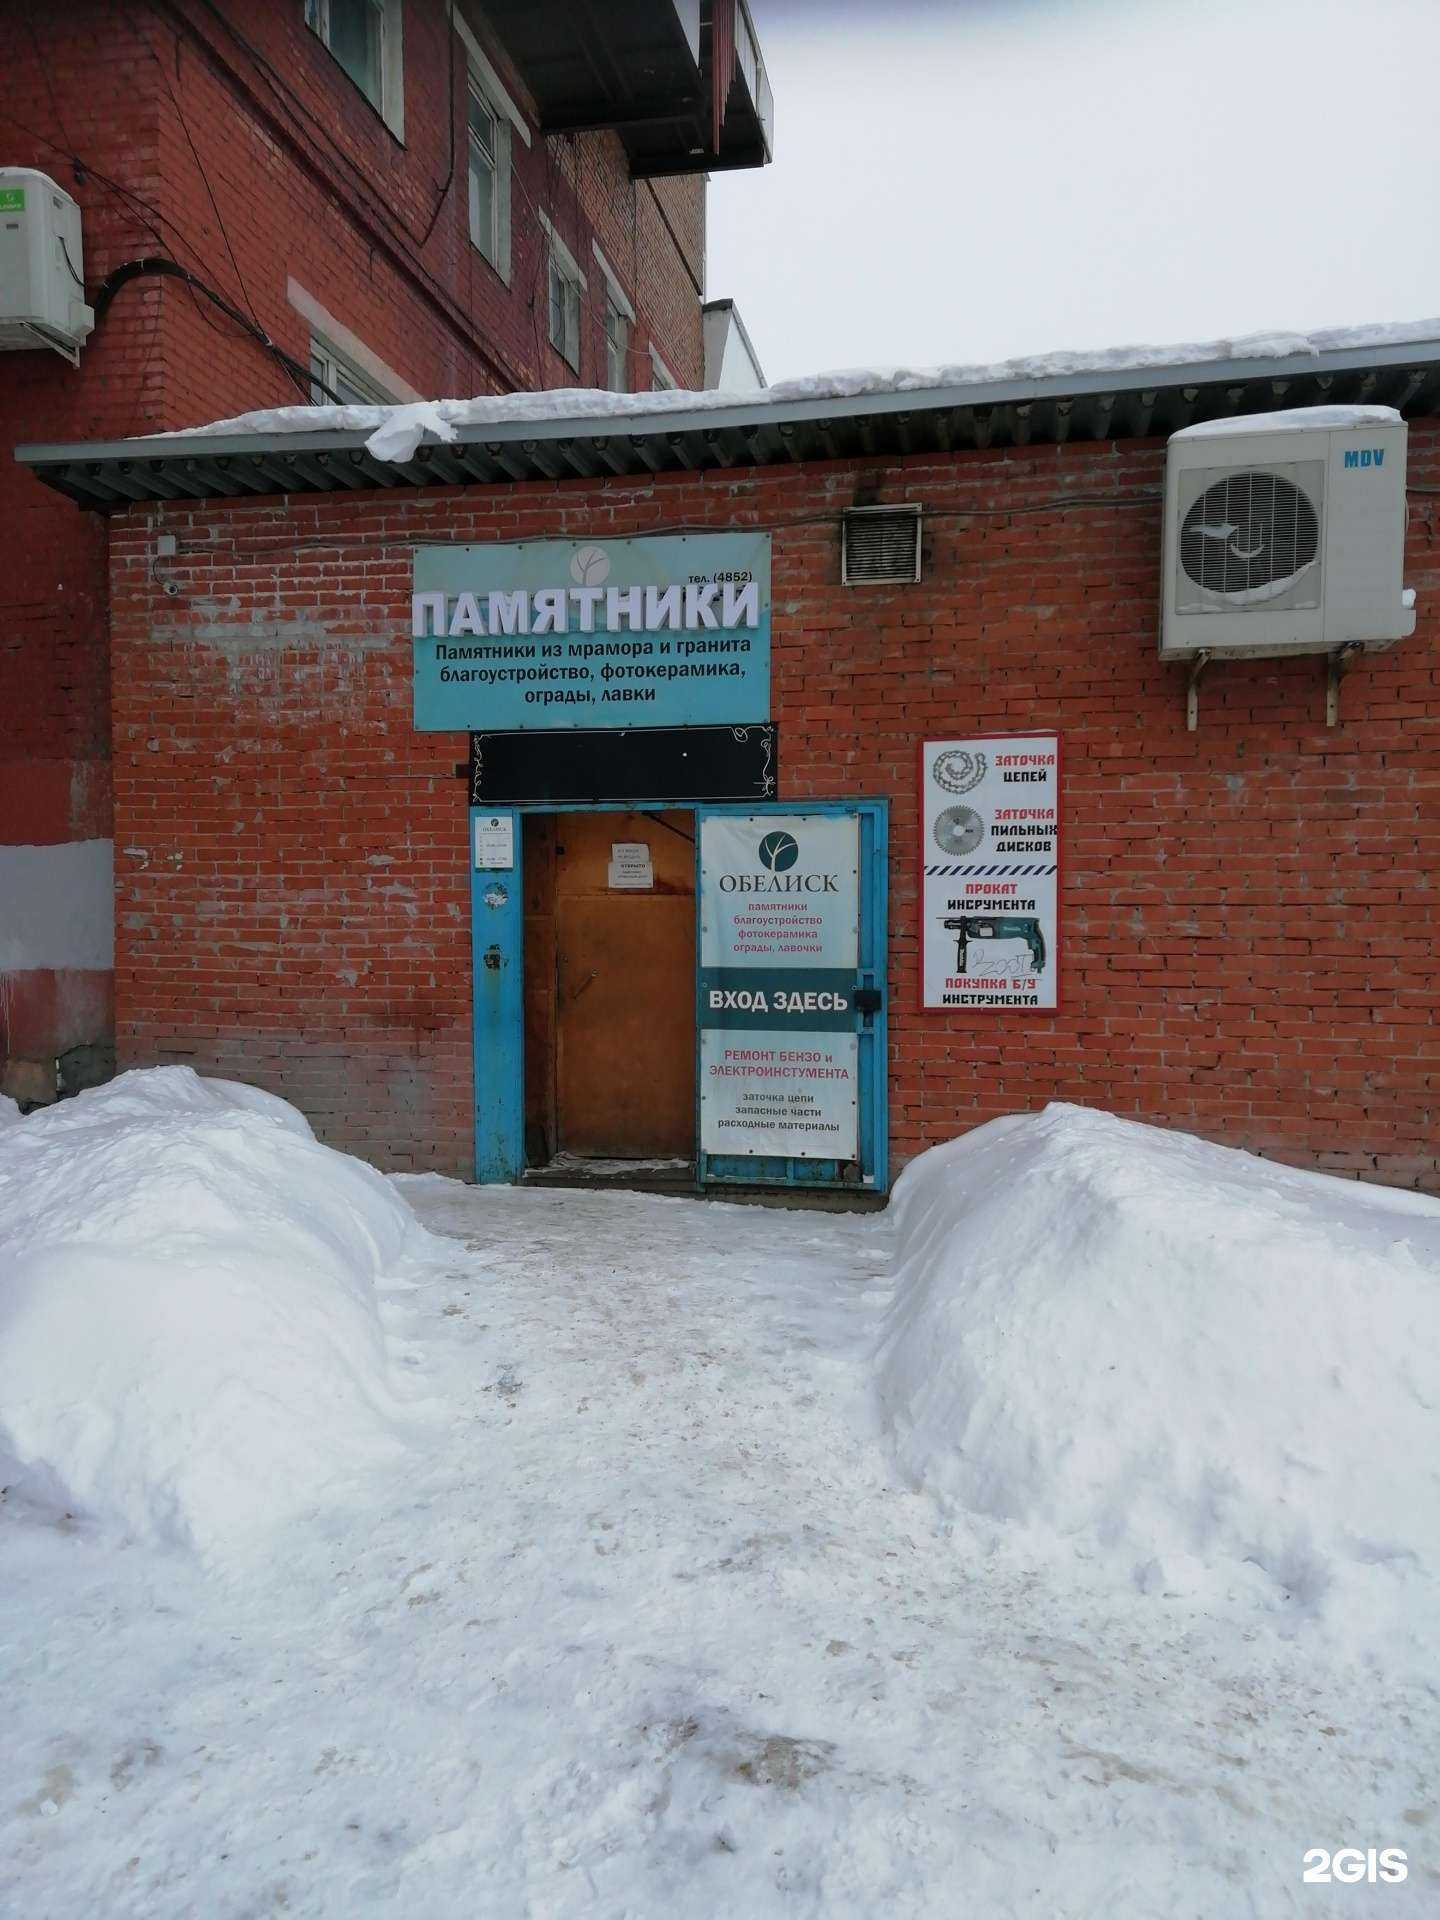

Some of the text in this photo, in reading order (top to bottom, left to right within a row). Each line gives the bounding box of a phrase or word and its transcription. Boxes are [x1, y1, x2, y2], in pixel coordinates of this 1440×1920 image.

[1344, 448, 1385, 468] MDV
[688, 571, 752, 583] тел. (4852)
[412, 582, 759, 637] ПАМЯТНИКИ
[436, 638, 752, 661] Памятники из мрамора и гранита
[440, 662, 747, 684] благоустройство, фотокерамика,
[524, 687, 656, 706] ограды, лавки
[995, 754, 1055, 766] ЗАТОЧКА
[1003, 768, 1047, 783] ЦЕПЕЙ
[994, 808, 1055, 820] ЗАТОЧКА
[991, 825, 1058, 836] ПИЛЬНЫХ
[996, 841, 1052, 853] ДИСКОВ
[719, 873, 839, 893] ОБЕЛИСК
[965, 883, 1018, 895] ПРОКАТ
[748, 903, 808, 911] памятники
[947, 899, 1036, 911] ИНСРУМЕНТА
[733, 915, 823, 926] благоустройство
[738, 930, 818, 939] фотокерамика
[733, 943, 823, 953] ограды, лавочки
[945, 978, 1036, 991] ПОКУПКА Б/У
[709, 990, 848, 1013] ВХОД ЗДЕСЬ
[942, 994, 1039, 1006] ИНСТРУМЕНТА
[724, 1050, 833, 1063] РЕМОНТ БЕНЗО и
[709, 1065, 849, 1080] ЭЛЕКТРОИНСТУМЕНТА
[743, 1093, 814, 1104] заточка цепи
[735, 1106, 821, 1117] запасные части
[718, 1119, 840, 1132] расходные материалы
